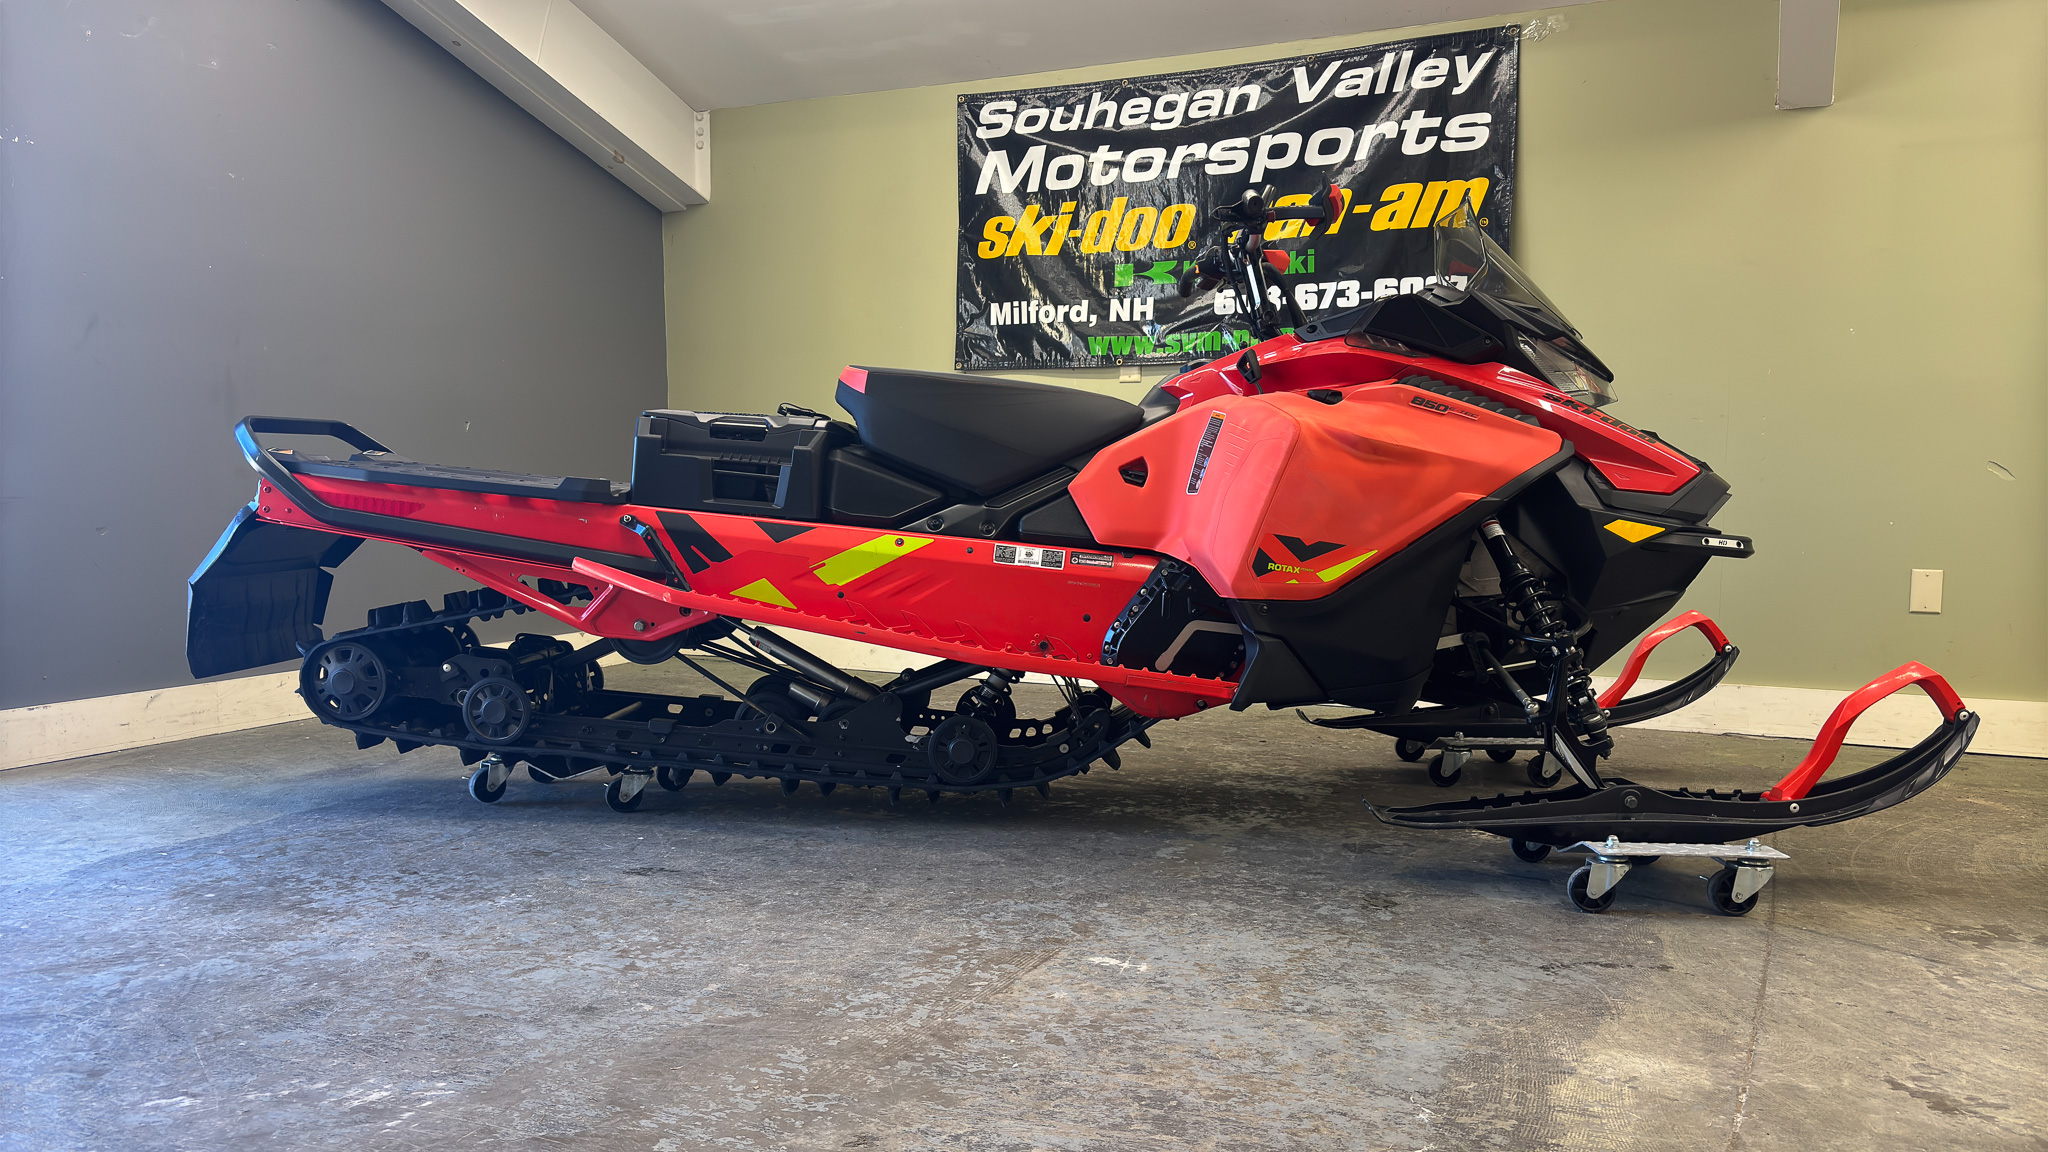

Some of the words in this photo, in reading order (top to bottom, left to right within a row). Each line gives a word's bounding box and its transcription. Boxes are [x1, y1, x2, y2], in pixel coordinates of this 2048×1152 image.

[976, 83, 1262, 139] Souhegan
[1293, 50, 1493, 104] Valley
[975, 109, 1492, 195] Motorsports
[977, 196, 1196, 260] ski-doo
[1228, 177, 1490, 243] an-am
[990, 299, 1098, 328] Milford,
[1109, 297, 1154, 322] NH
[1411, 396, 1449, 412] 850
[1267, 562, 1301, 574] ROTAX
